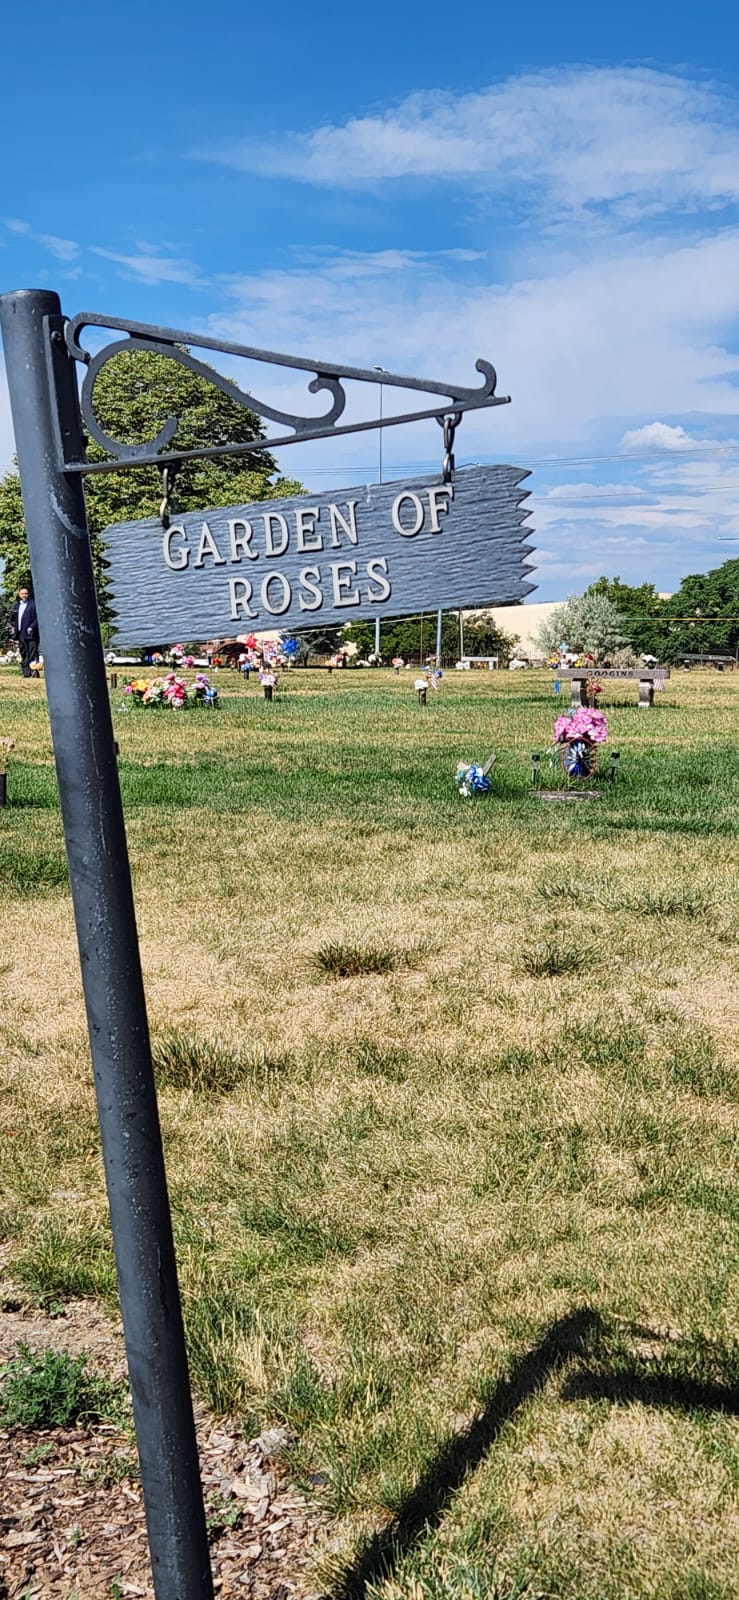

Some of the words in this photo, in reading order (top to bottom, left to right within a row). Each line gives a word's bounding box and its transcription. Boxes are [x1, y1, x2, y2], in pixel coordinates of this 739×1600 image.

[163, 501, 359, 571] GARDEN
[391, 485, 454, 537] OF
[228, 557, 392, 620] ROSES
